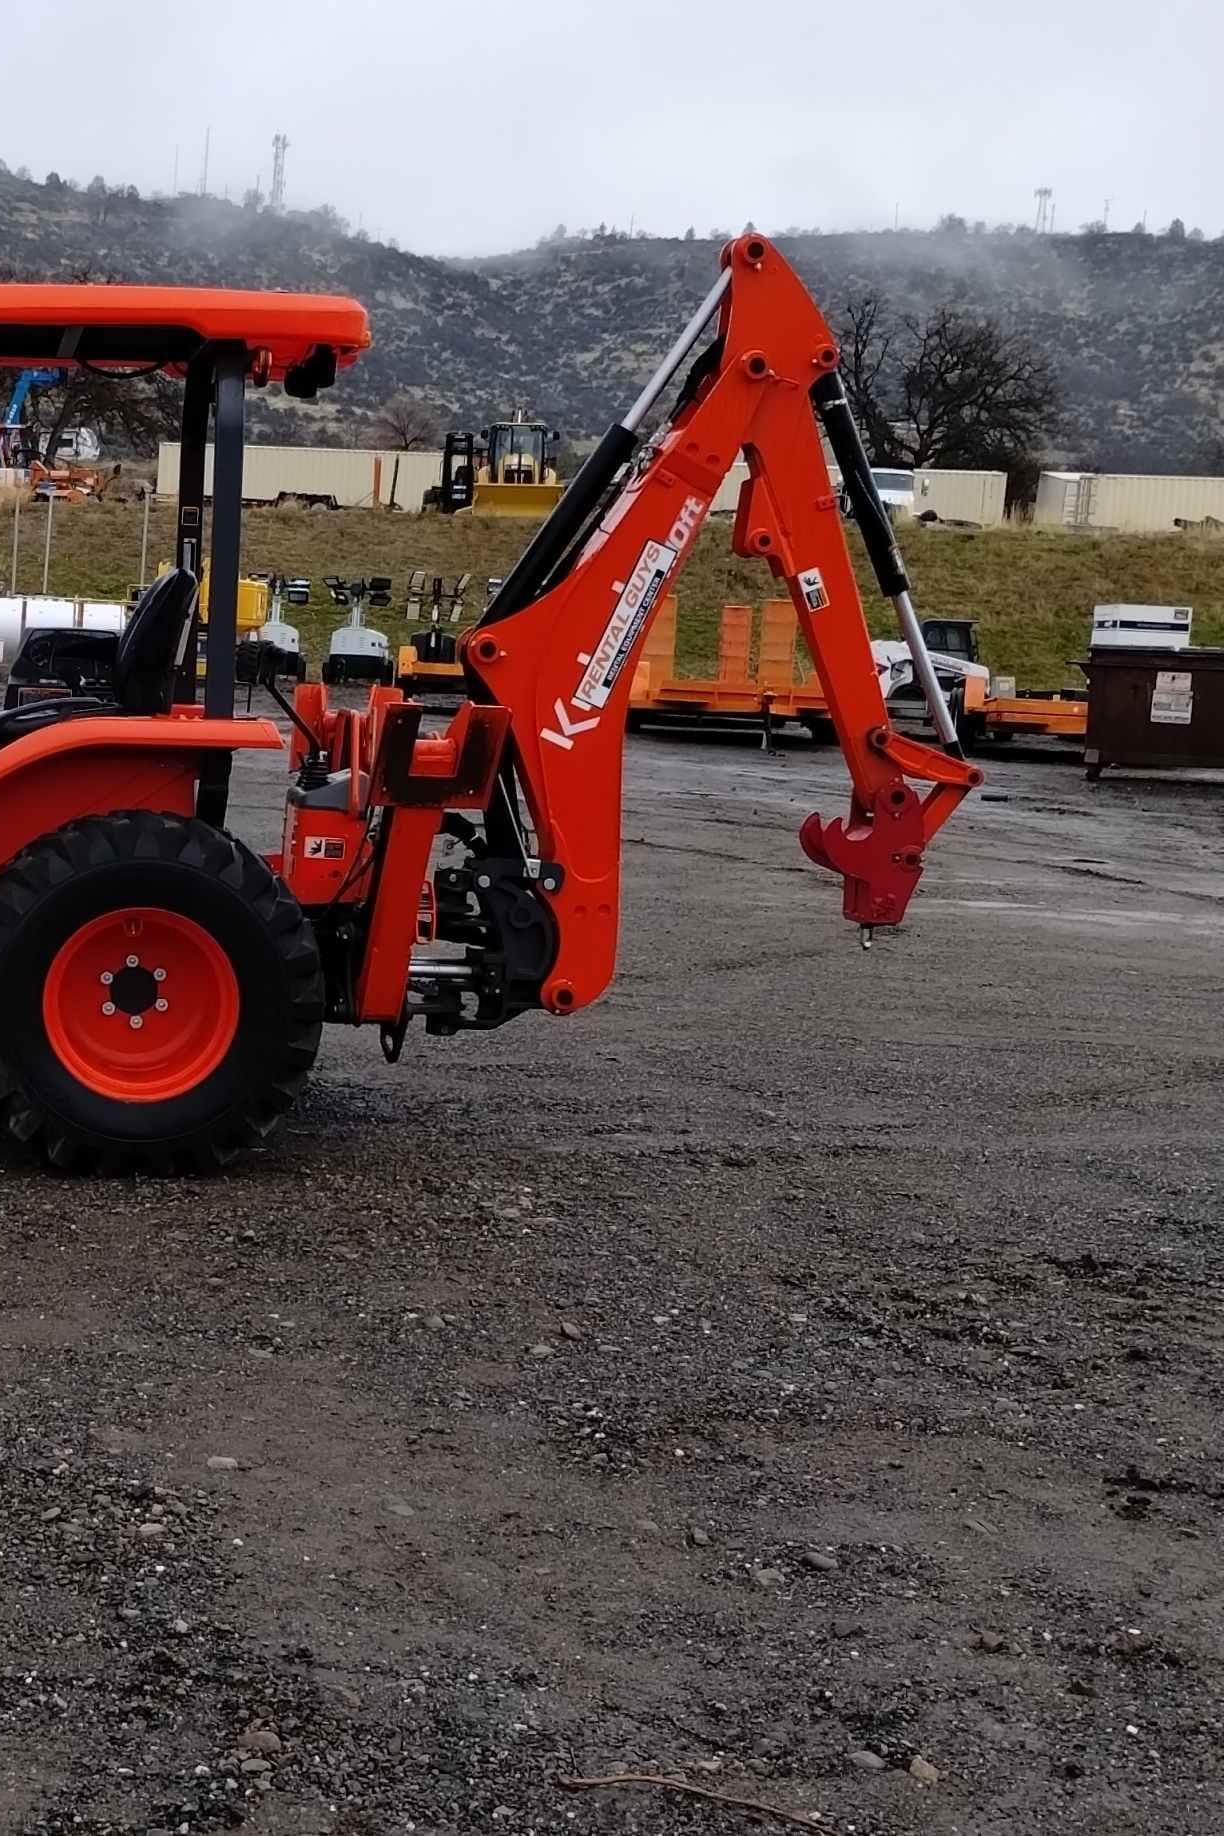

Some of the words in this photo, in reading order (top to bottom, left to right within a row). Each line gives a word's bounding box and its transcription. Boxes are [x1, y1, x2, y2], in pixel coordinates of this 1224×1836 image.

[580, 613, 630, 700] RENTAL
[626, 543, 661, 608] GUYS
[642, 576, 661, 611] CENTER
